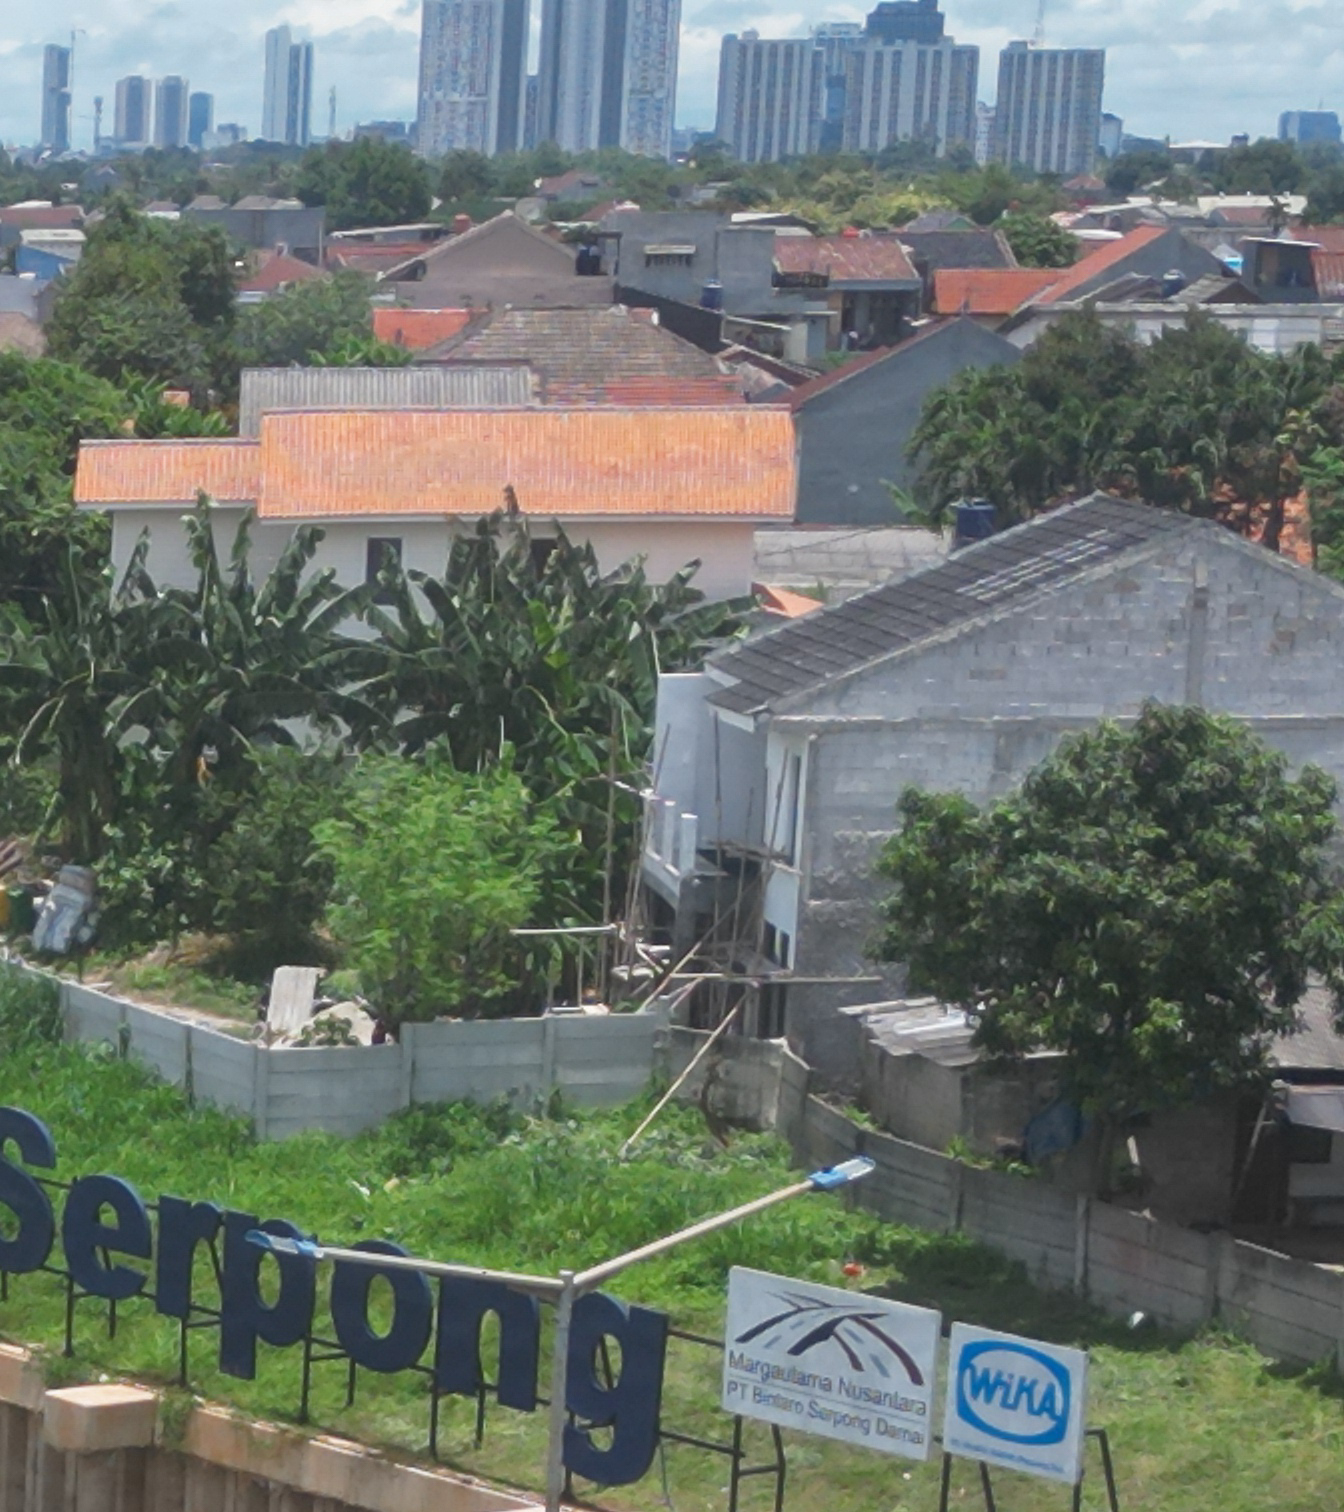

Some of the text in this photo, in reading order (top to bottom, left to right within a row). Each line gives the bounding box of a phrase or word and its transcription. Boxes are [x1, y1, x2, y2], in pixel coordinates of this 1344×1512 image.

[726, 1381, 749, 1400] PT
[807, 1399, 871, 1435] Serpong
[728, 1350, 927, 1416] Margautama Nusantara
